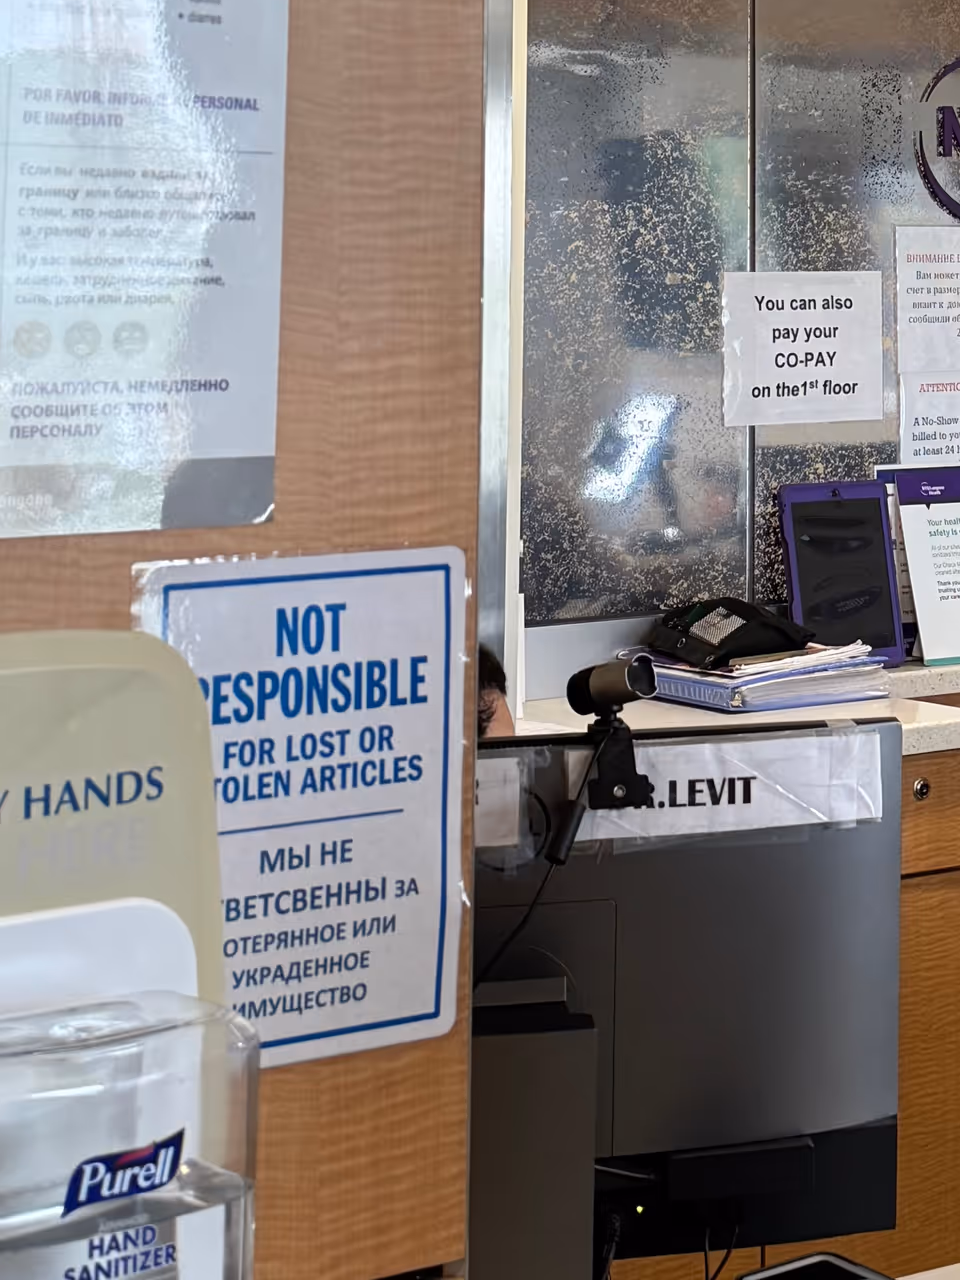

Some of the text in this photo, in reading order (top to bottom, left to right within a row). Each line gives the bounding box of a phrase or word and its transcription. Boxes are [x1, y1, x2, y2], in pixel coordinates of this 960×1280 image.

[193, 94, 260, 112] PERSONAL
[906, 253, 955, 264] ВНИМАНИЕ
[915, 271, 932, 280] Вам
[754, 295, 853, 312] You can also
[772, 326, 839, 343] pay your
[774, 351, 837, 369] CO-PAY
[128, 378, 229, 395] НЕМЕДЛЕННО
[751, 385, 771, 398] on
[822, 379, 858, 395] floor
[10, 403, 98, 419] СООБЩИТЕ
[912, 417, 920, 427] A
[921, 415, 958, 427] No-Show
[10, 423, 103, 439] ПЕРСОНАЛУ
[912, 431, 937, 442] billed
[938, 432, 947, 441] to
[913, 446, 922, 457] at
[922, 446, 943, 456] least
[944, 445, 956, 455] 24
[927, 519, 943, 527] Your
[929, 528, 950, 538] safety
[951, 528, 958, 536] is
[275, 602, 347, 657] NOT
[198, 655, 428, 726] ESPONSIBLE
[223, 724, 394, 769] FOR LOST OR
[299, 754, 423, 795] ARTICLES
[23, 765, 164, 820] HANDS
[259, 838, 354, 874] МЫ НЕ
[222, 876, 420, 922] ВЕТСВЕННЫ ЗА
[223, 914, 397, 958] ОТЕРЯННОЕ ИЛИ
[232, 950, 371, 990] УКРАДЕННОЕ
[78, 1146, 175, 1202] Purell
[88, 1224, 157, 1259] HAND
[64, 1244, 177, 1280] SANITIZER
